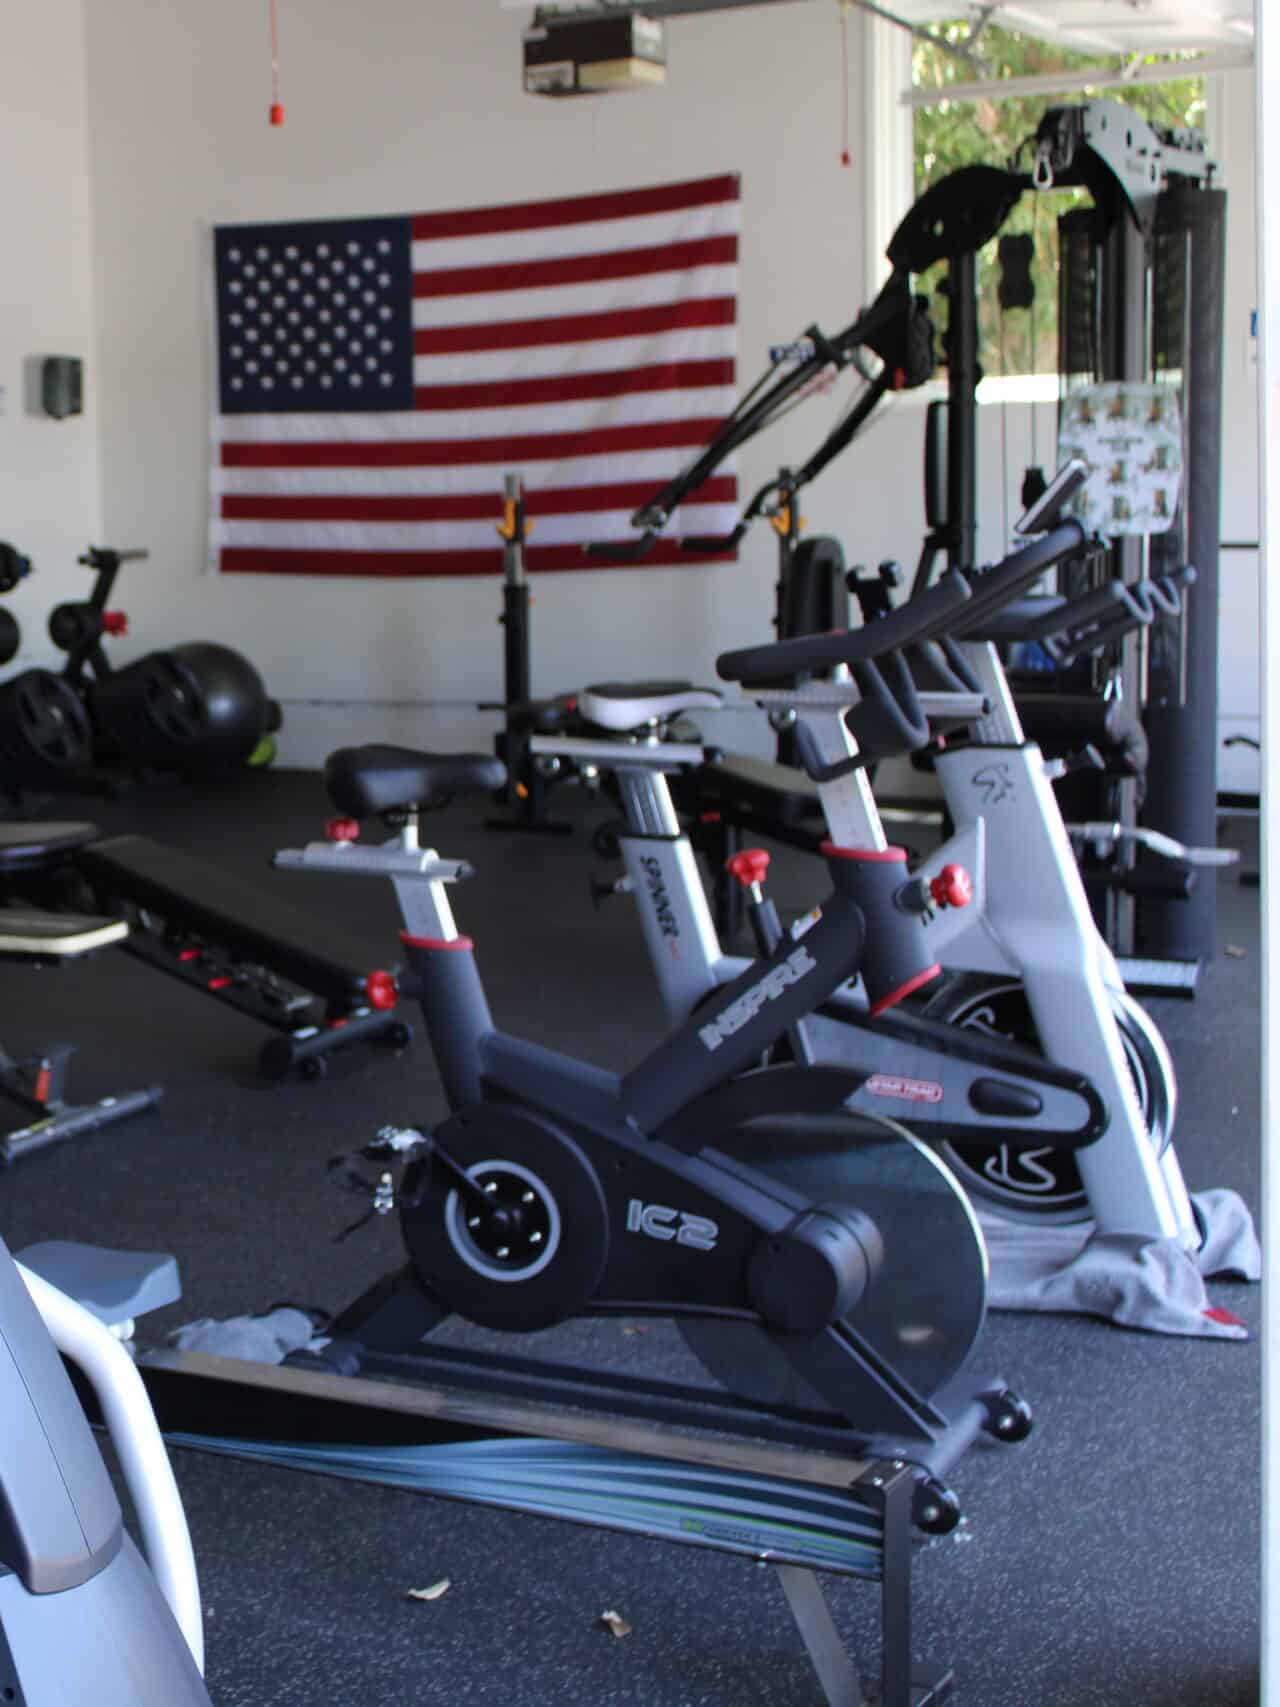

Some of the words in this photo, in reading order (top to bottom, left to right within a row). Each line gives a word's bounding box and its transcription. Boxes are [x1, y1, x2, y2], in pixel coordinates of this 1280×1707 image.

[640, 855, 679, 937] SPINNER
[699, 945, 817, 1052] INSPIRE
[627, 1199, 718, 1251] IC2
